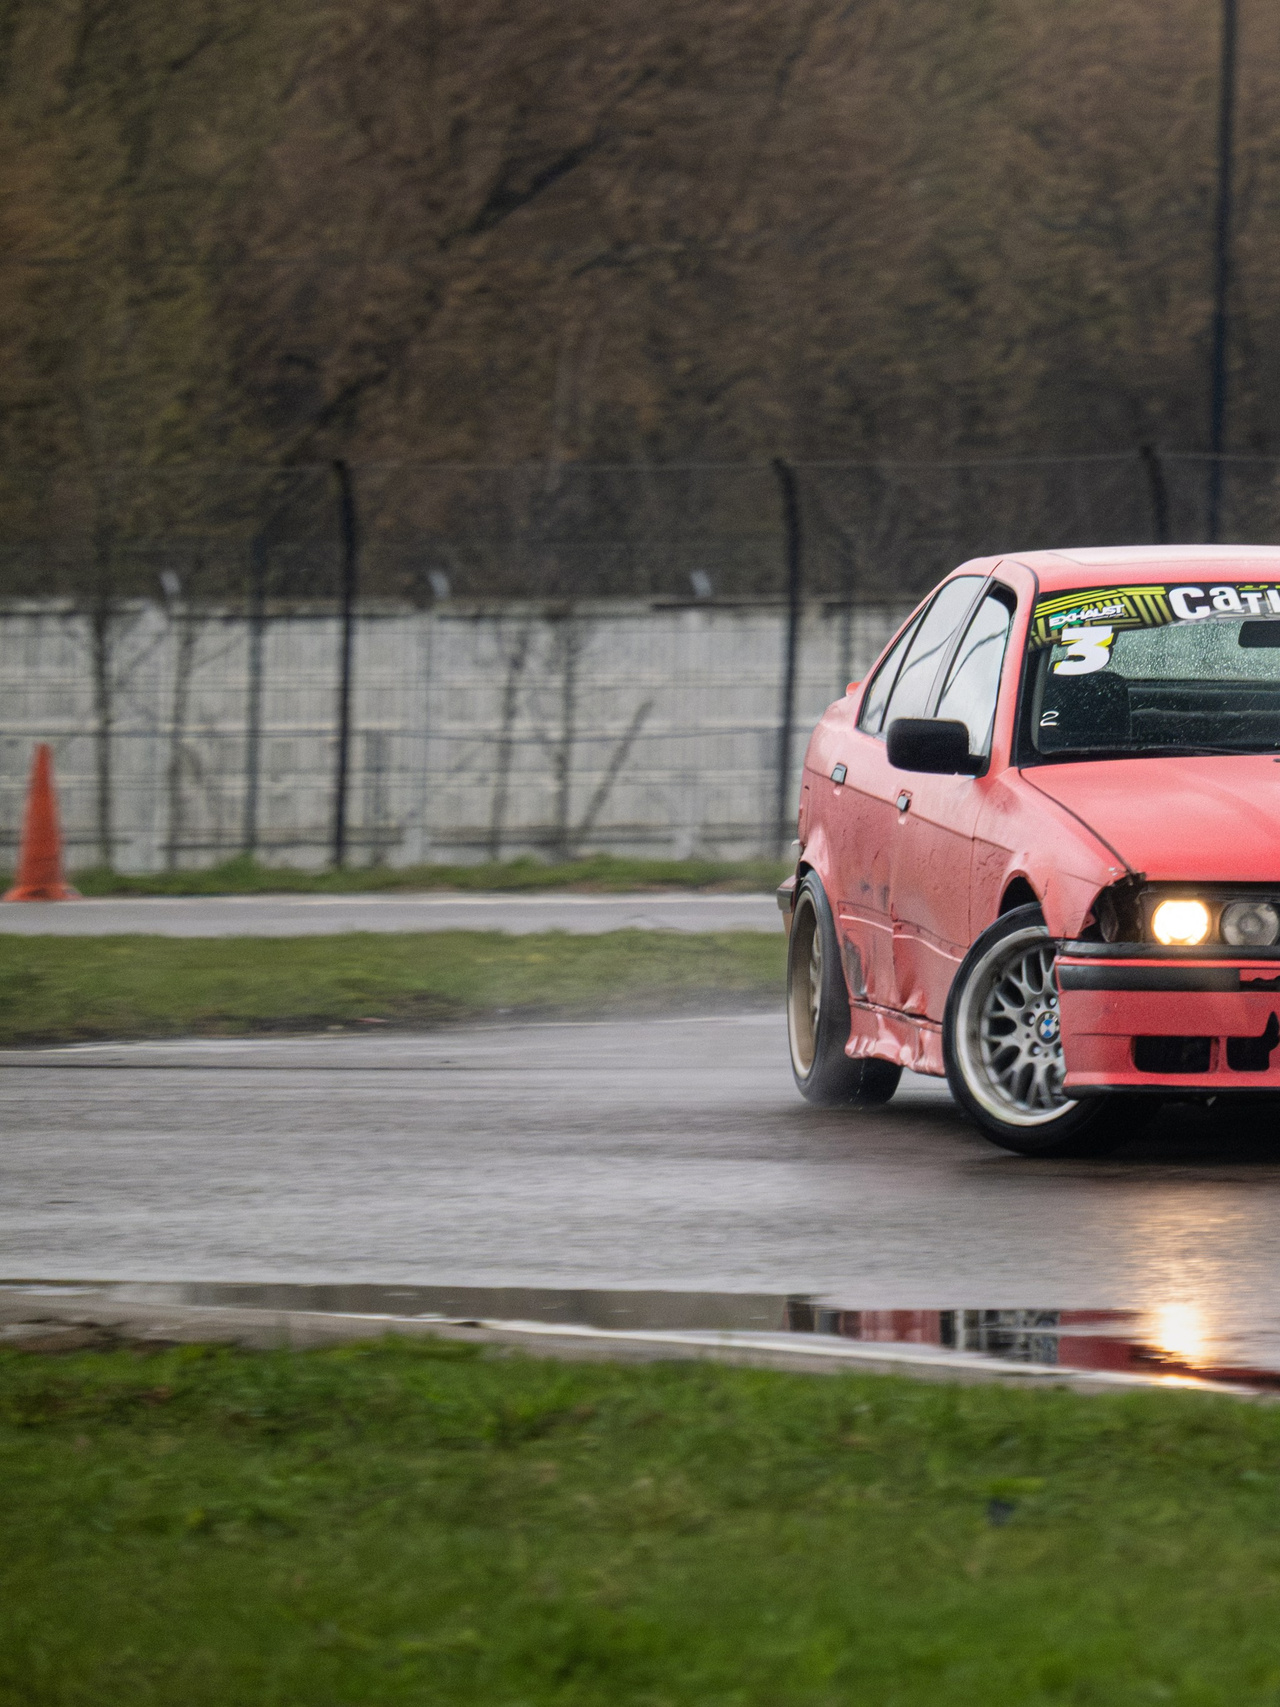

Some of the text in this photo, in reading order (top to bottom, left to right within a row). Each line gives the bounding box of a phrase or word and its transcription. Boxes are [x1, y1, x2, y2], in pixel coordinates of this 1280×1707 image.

[1049, 604, 1125, 628] EXHAUST
[1053, 625, 1113, 676] 3
[1039, 710, 1060, 727] 2
